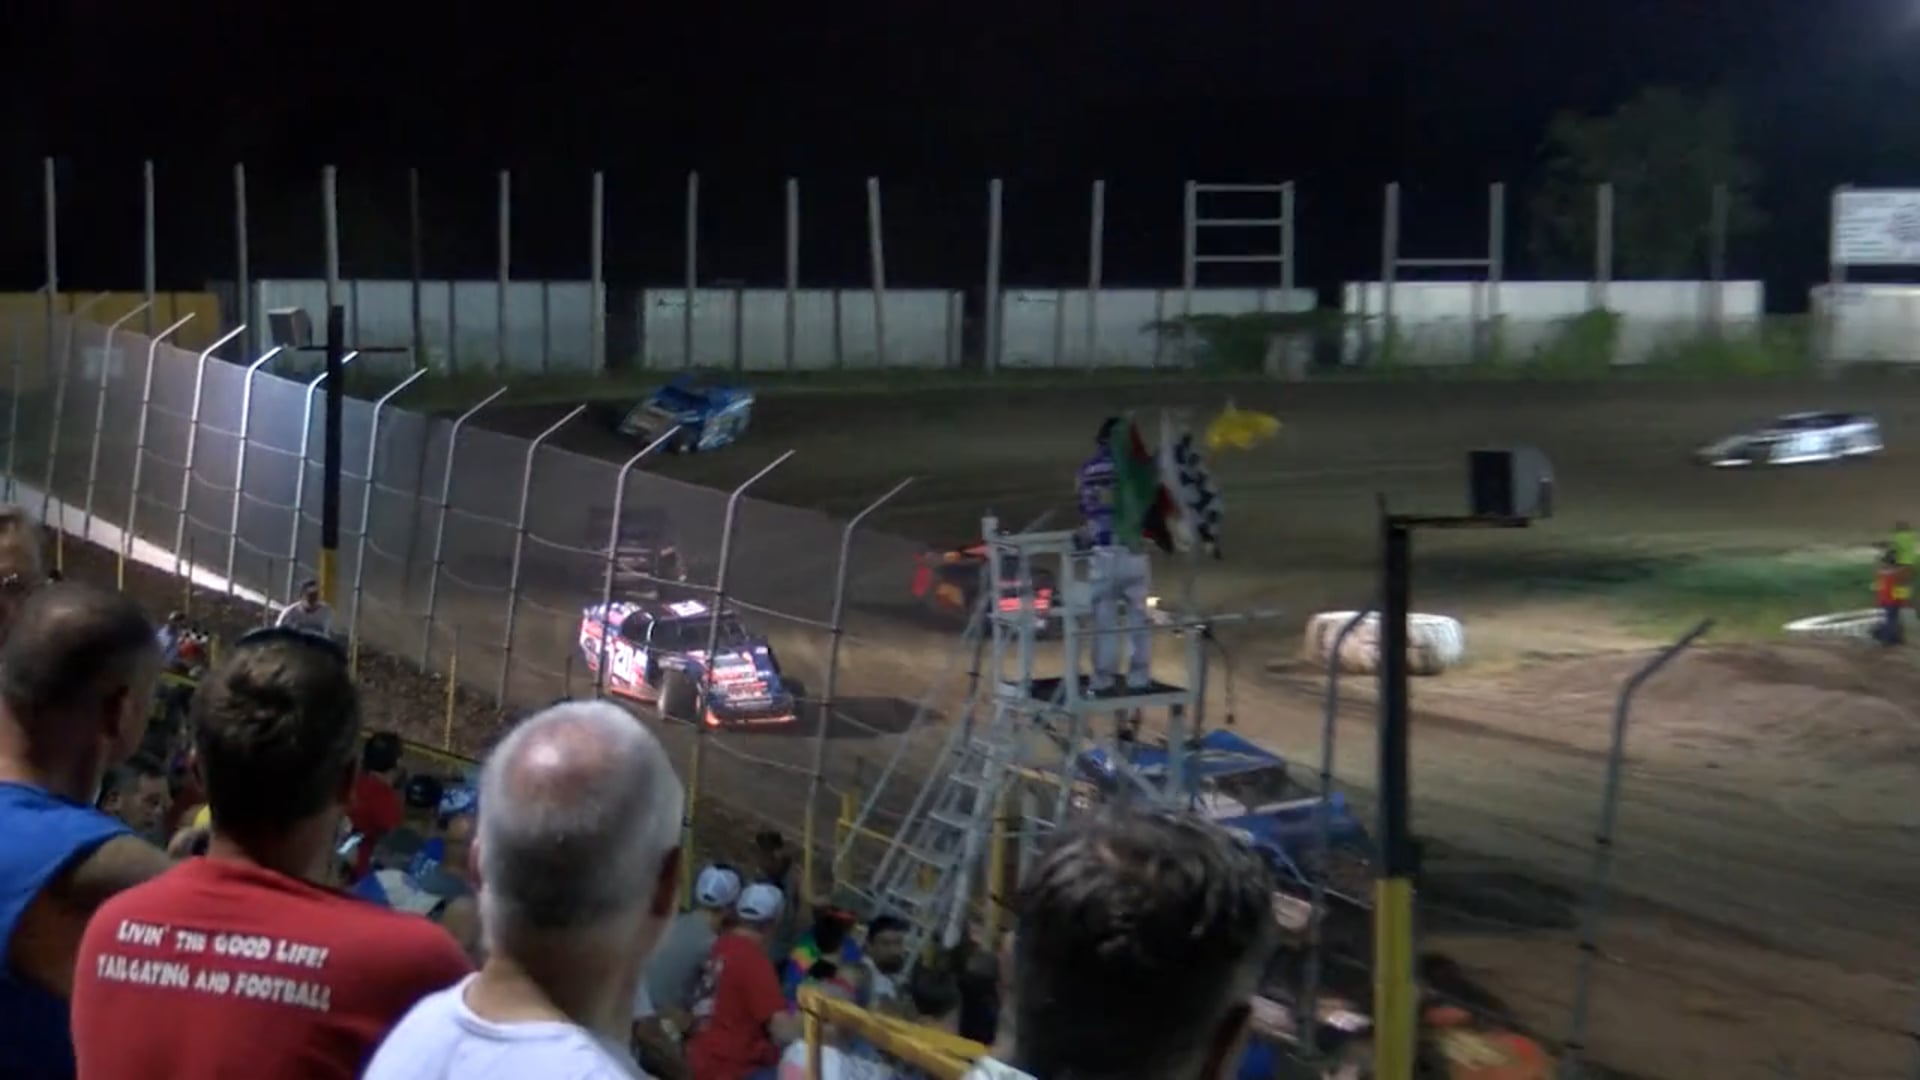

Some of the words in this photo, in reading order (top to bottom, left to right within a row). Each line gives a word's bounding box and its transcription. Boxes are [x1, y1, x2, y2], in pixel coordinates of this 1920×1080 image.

[117, 920, 171, 947] LIVIN'
[176, 930, 208, 953] THE
[215, 933, 272, 961] GOOD
[276, 939, 329, 968] LIFE!
[97, 954, 190, 988] TAILGATING
[194, 970, 231, 995] AND
[235, 972, 331, 1012] FOOTBALL
